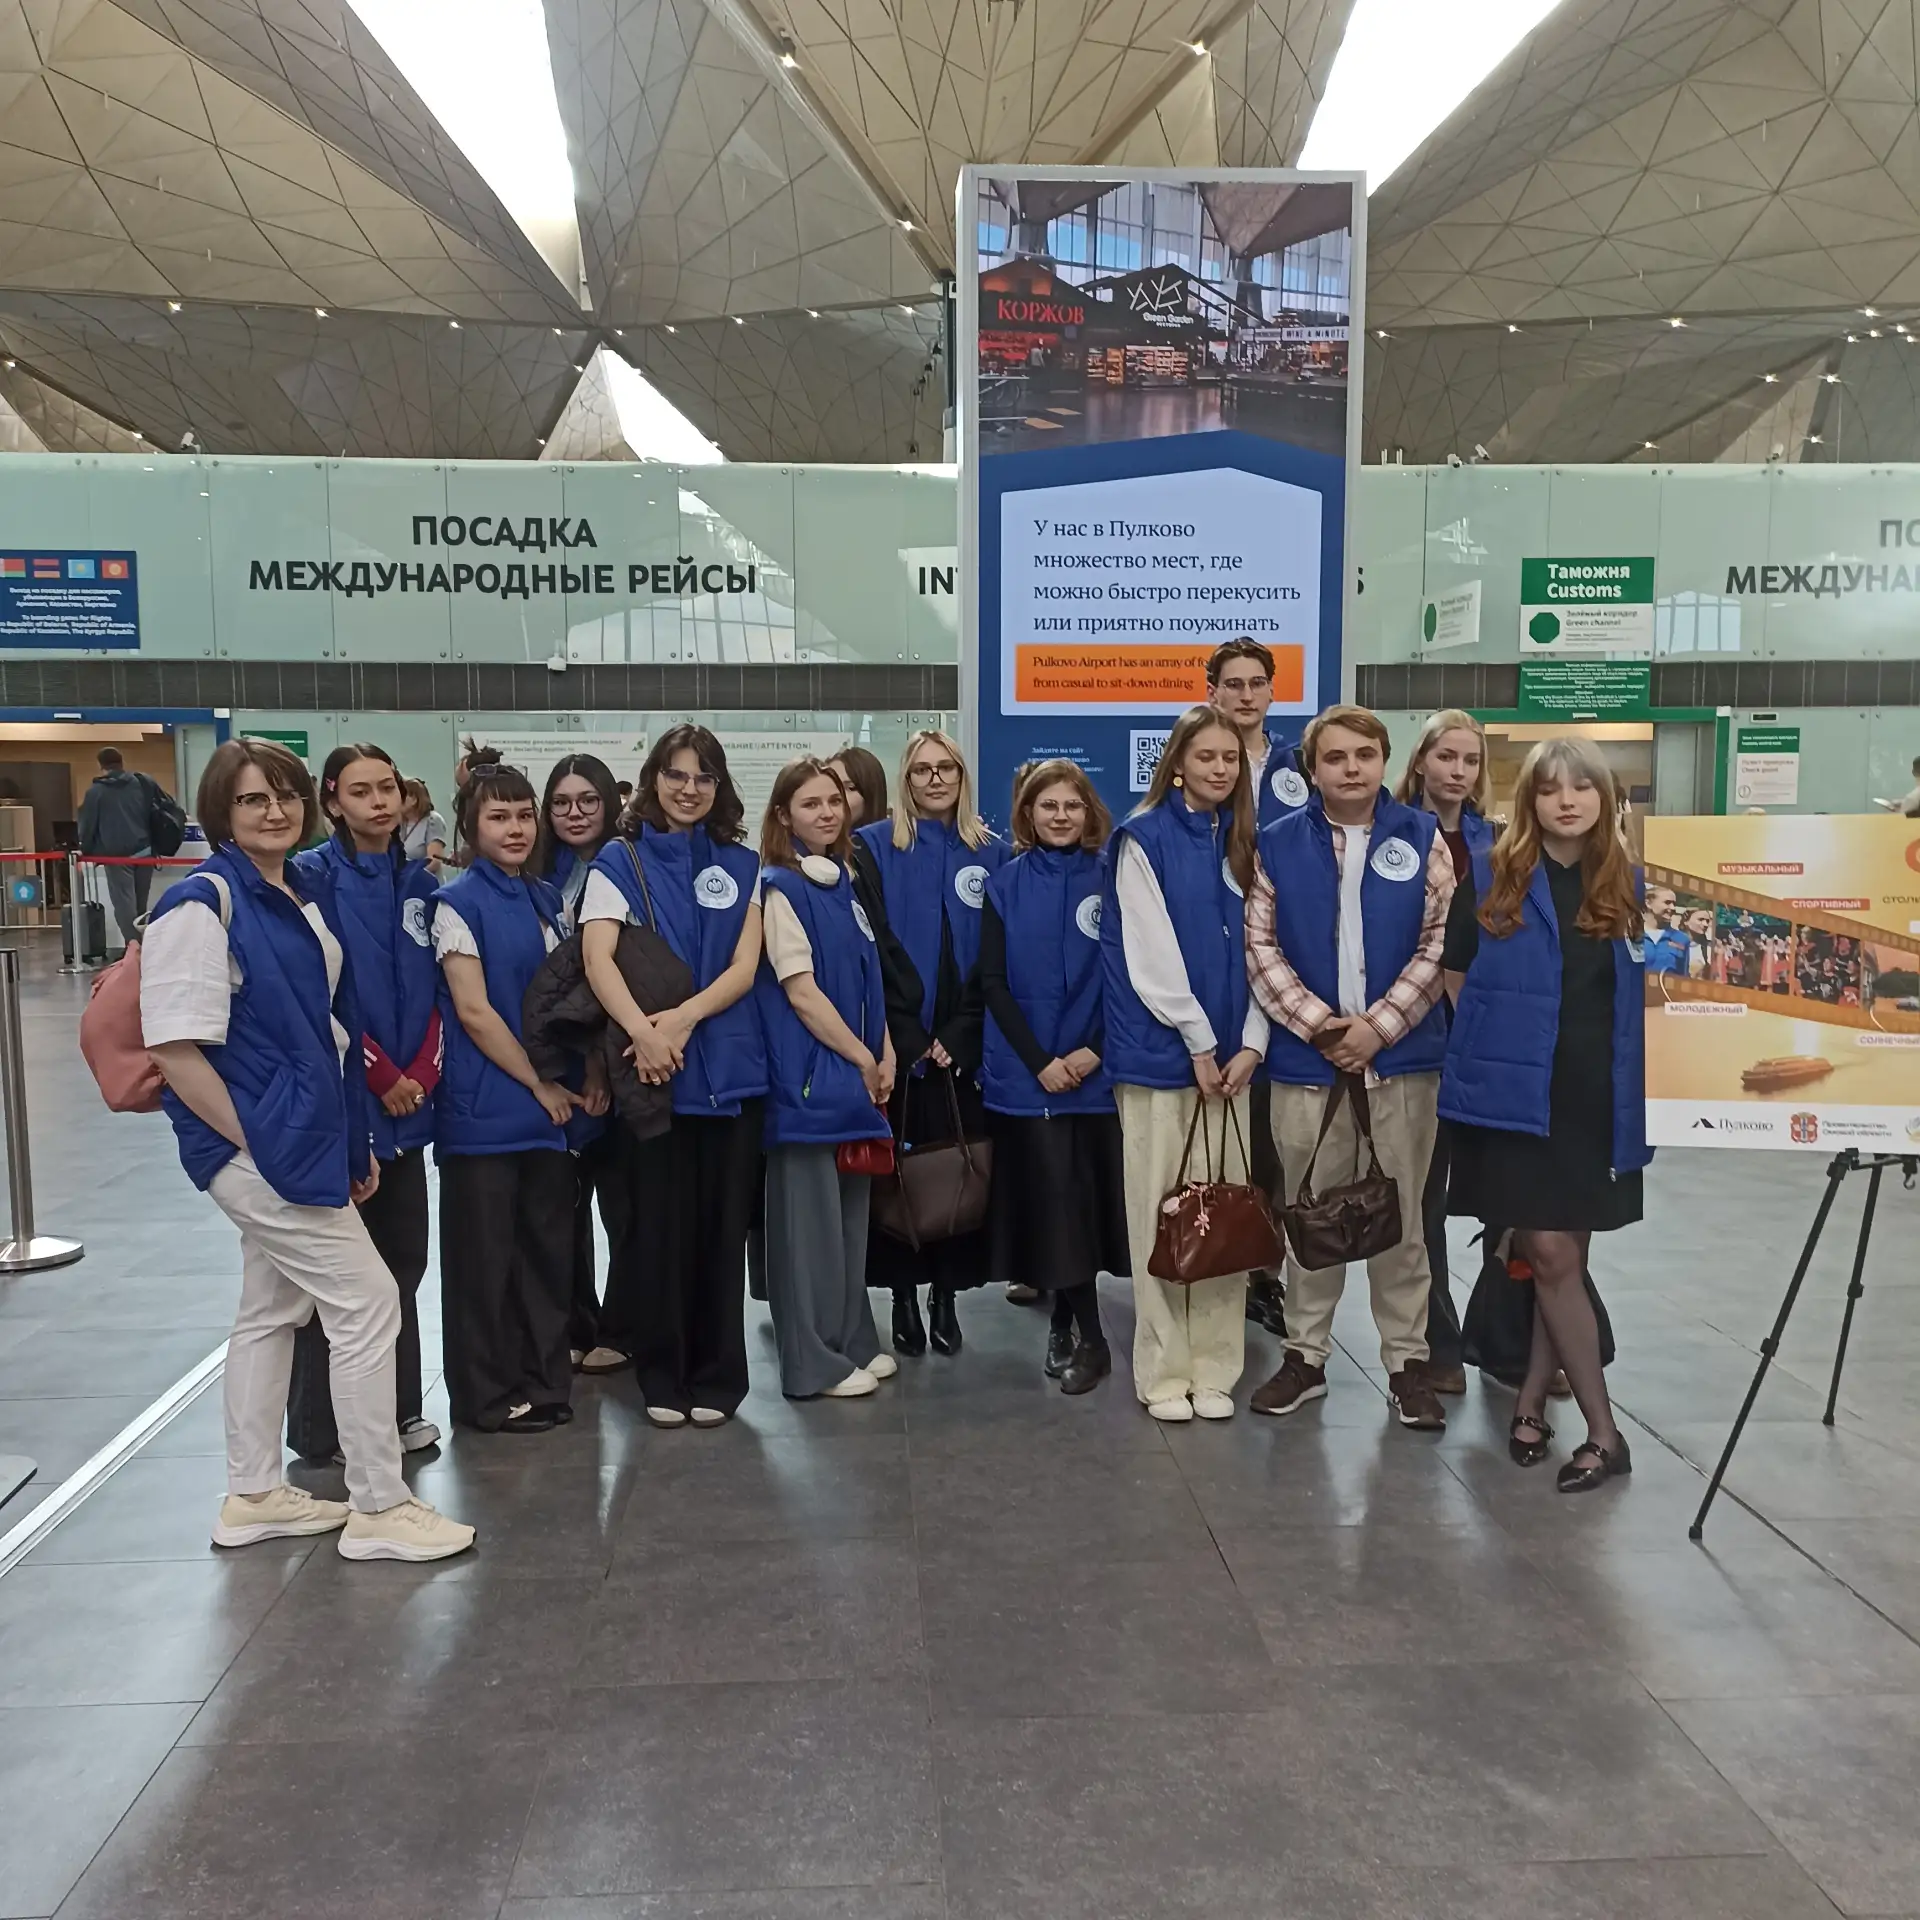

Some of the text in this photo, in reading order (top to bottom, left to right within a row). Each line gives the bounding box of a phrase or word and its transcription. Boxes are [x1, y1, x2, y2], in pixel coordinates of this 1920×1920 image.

[997, 298, 1084, 325] КОРЖОВ
[1143, 312, 1194, 324] Green Garden
[412, 515, 598, 553] ПОСАДКА
[1033, 520, 1195, 540] У нас в Пулково
[1033, 554, 1243, 571] множество мест, где
[248, 555, 756, 599] МЕЖДУНАРОДНЫЕ РЕЙСЫ
[1547, 563, 1631, 579] Таможня
[919, 567, 958, 594] IN
[1725, 564, 1920, 599] МЕЖДУНА
[1033, 582, 1301, 603] можно быстро перекусить
[1546, 582, 1622, 598] Customs
[1033, 617, 1280, 634] или приятно поужинать
[1033, 655, 1207, 670] Pulkovo Airport has an array of fo
[1033, 677, 1194, 690] from casual to sit-down dining
[1722, 864, 1799, 873] МУЗЫКАЛЬНЫЙ
[1791, 900, 1861, 909] СПОРТИВНЫЙ
[1669, 1003, 1743, 1013] МОЛОДЕЖНЫЙ
[1719, 1119, 1773, 1133] Пулково
